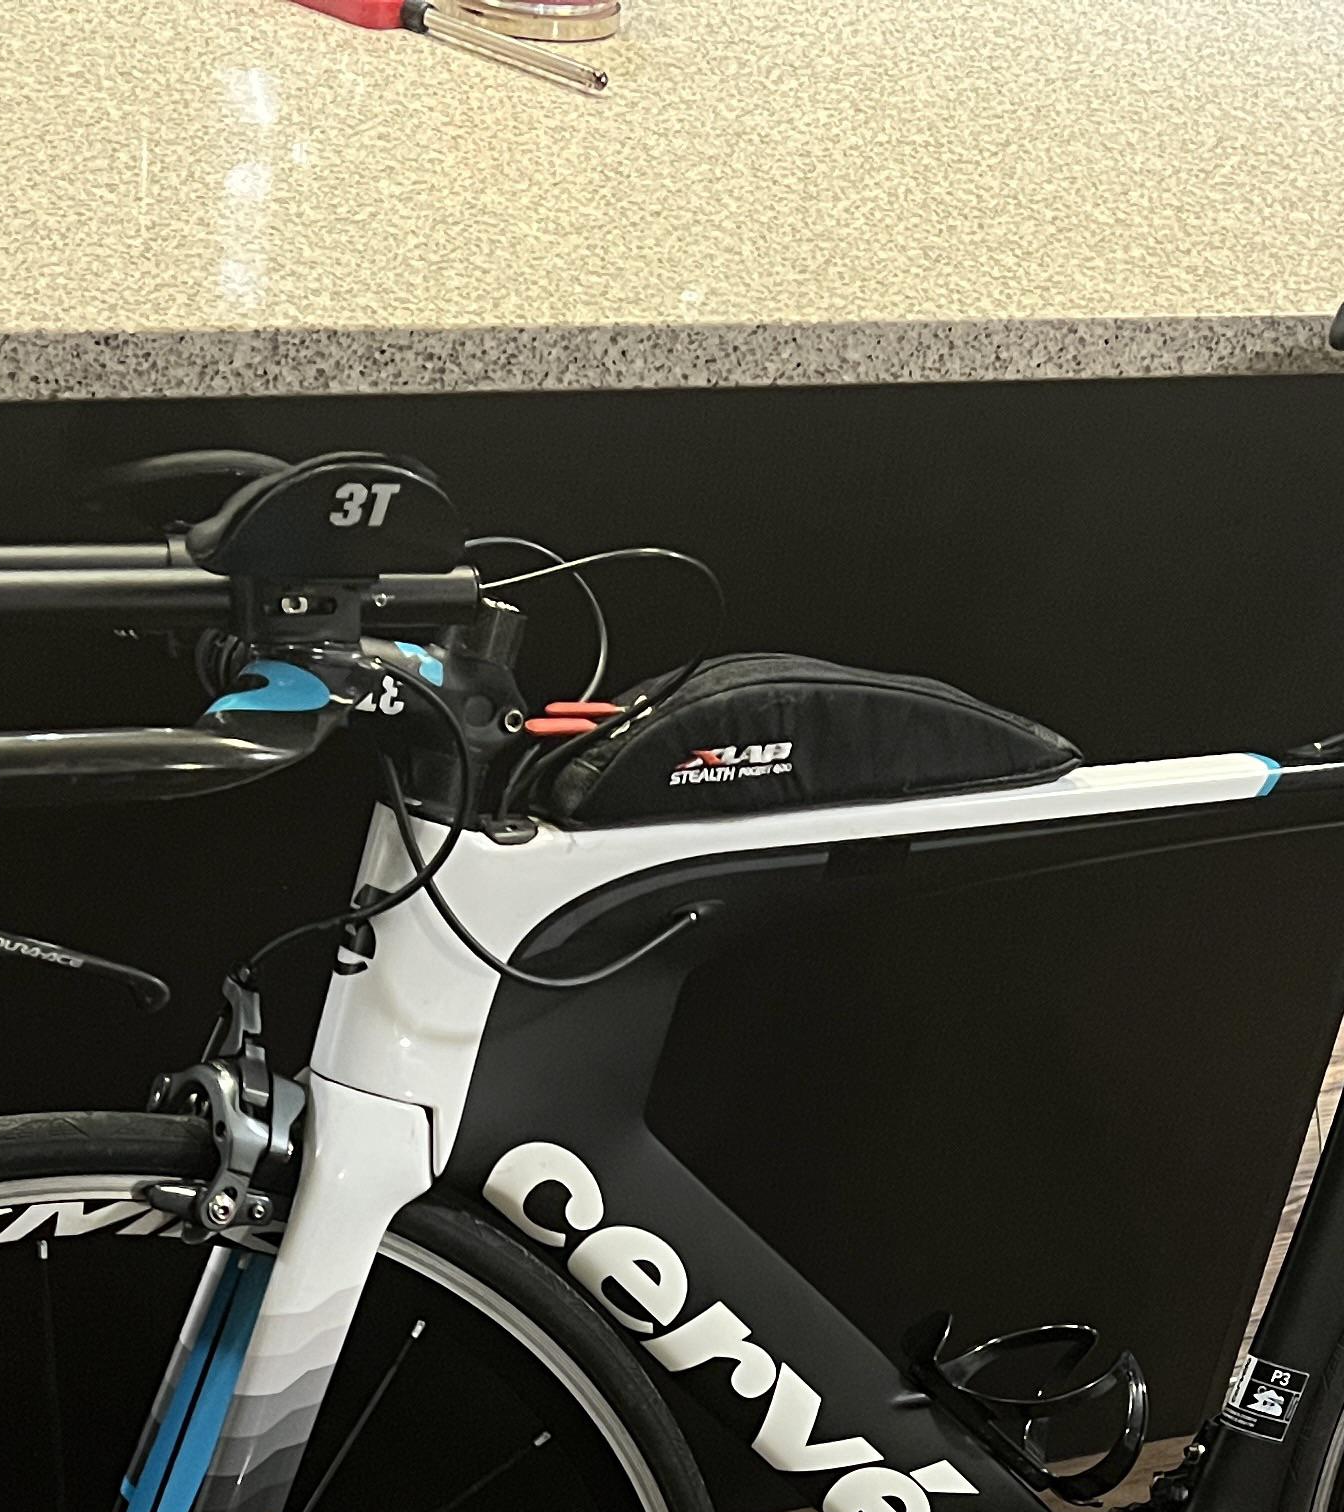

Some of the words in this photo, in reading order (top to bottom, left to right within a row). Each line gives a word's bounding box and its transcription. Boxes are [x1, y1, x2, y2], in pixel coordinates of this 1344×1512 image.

[329, 482, 401, 527] 3T
[674, 741, 793, 769] XLAB
[669, 765, 736, 786] STEALTH
[1270, 1369, 1292, 1387] P3
